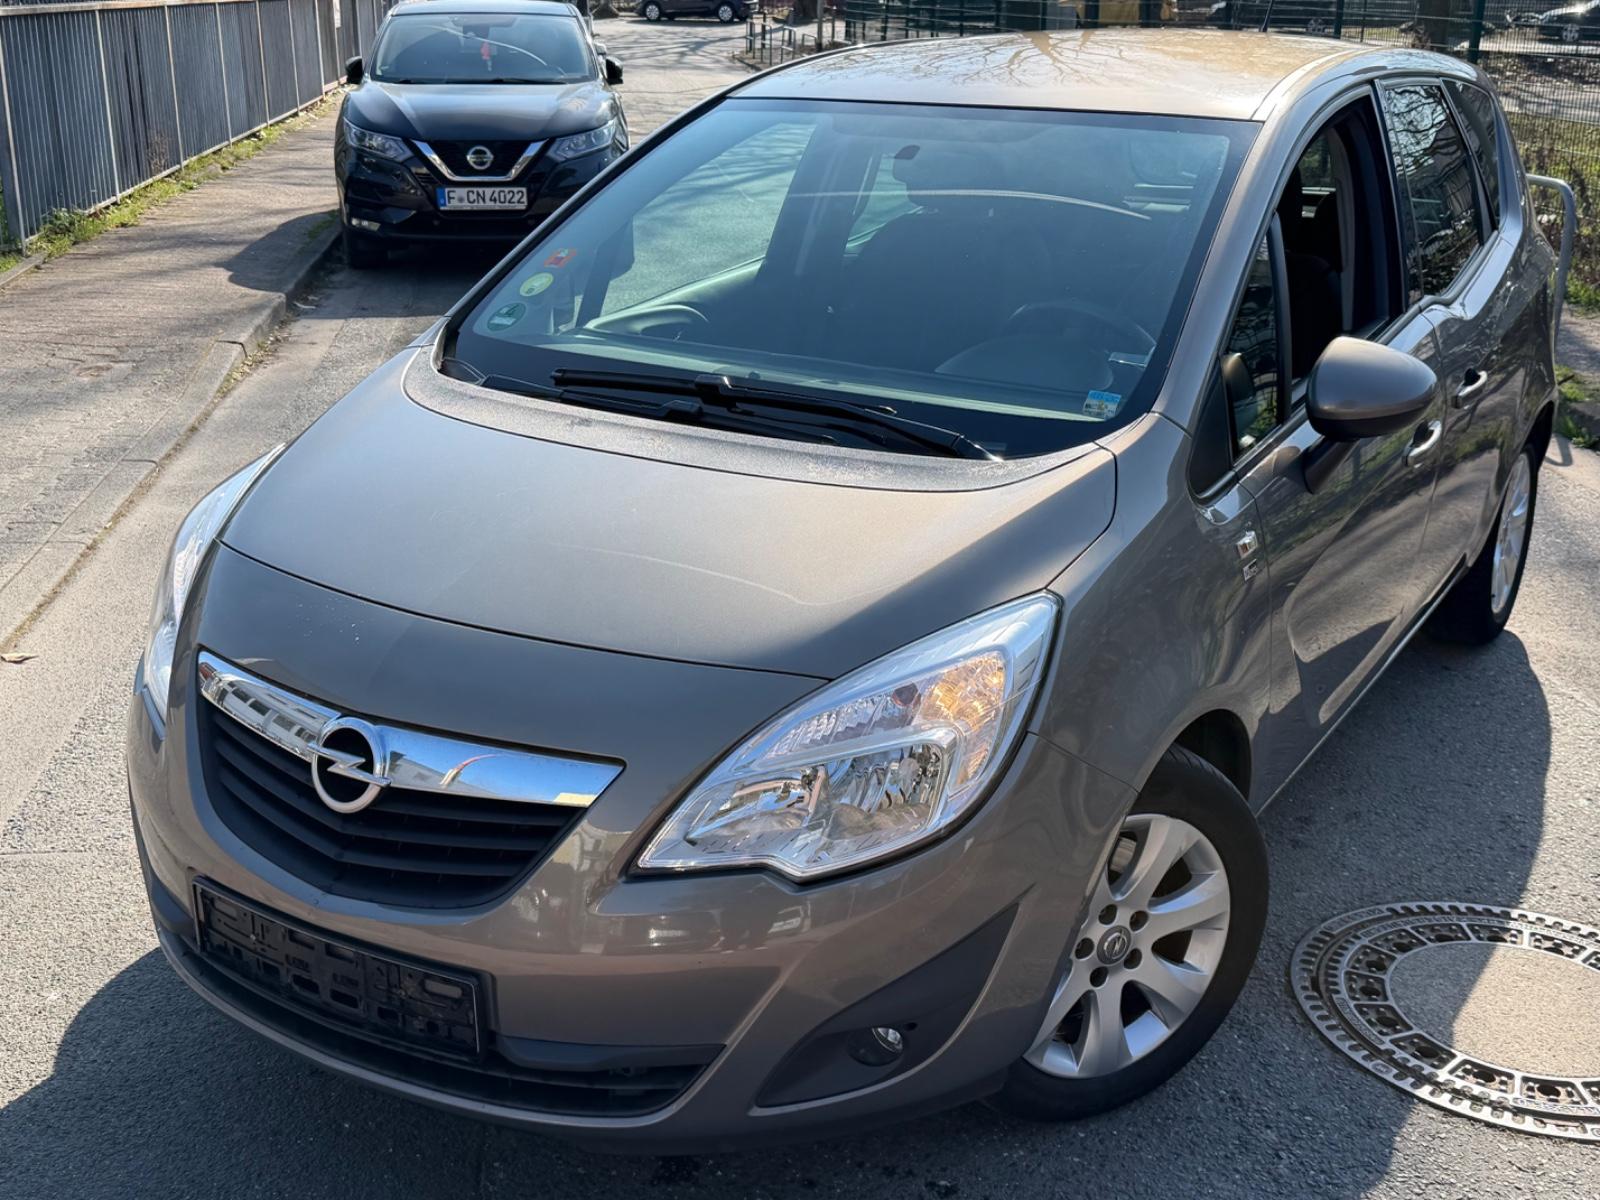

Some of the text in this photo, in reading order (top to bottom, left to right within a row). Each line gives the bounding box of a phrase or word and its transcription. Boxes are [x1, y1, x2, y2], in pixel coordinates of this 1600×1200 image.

[447, 190, 525, 204] F CN 4022
